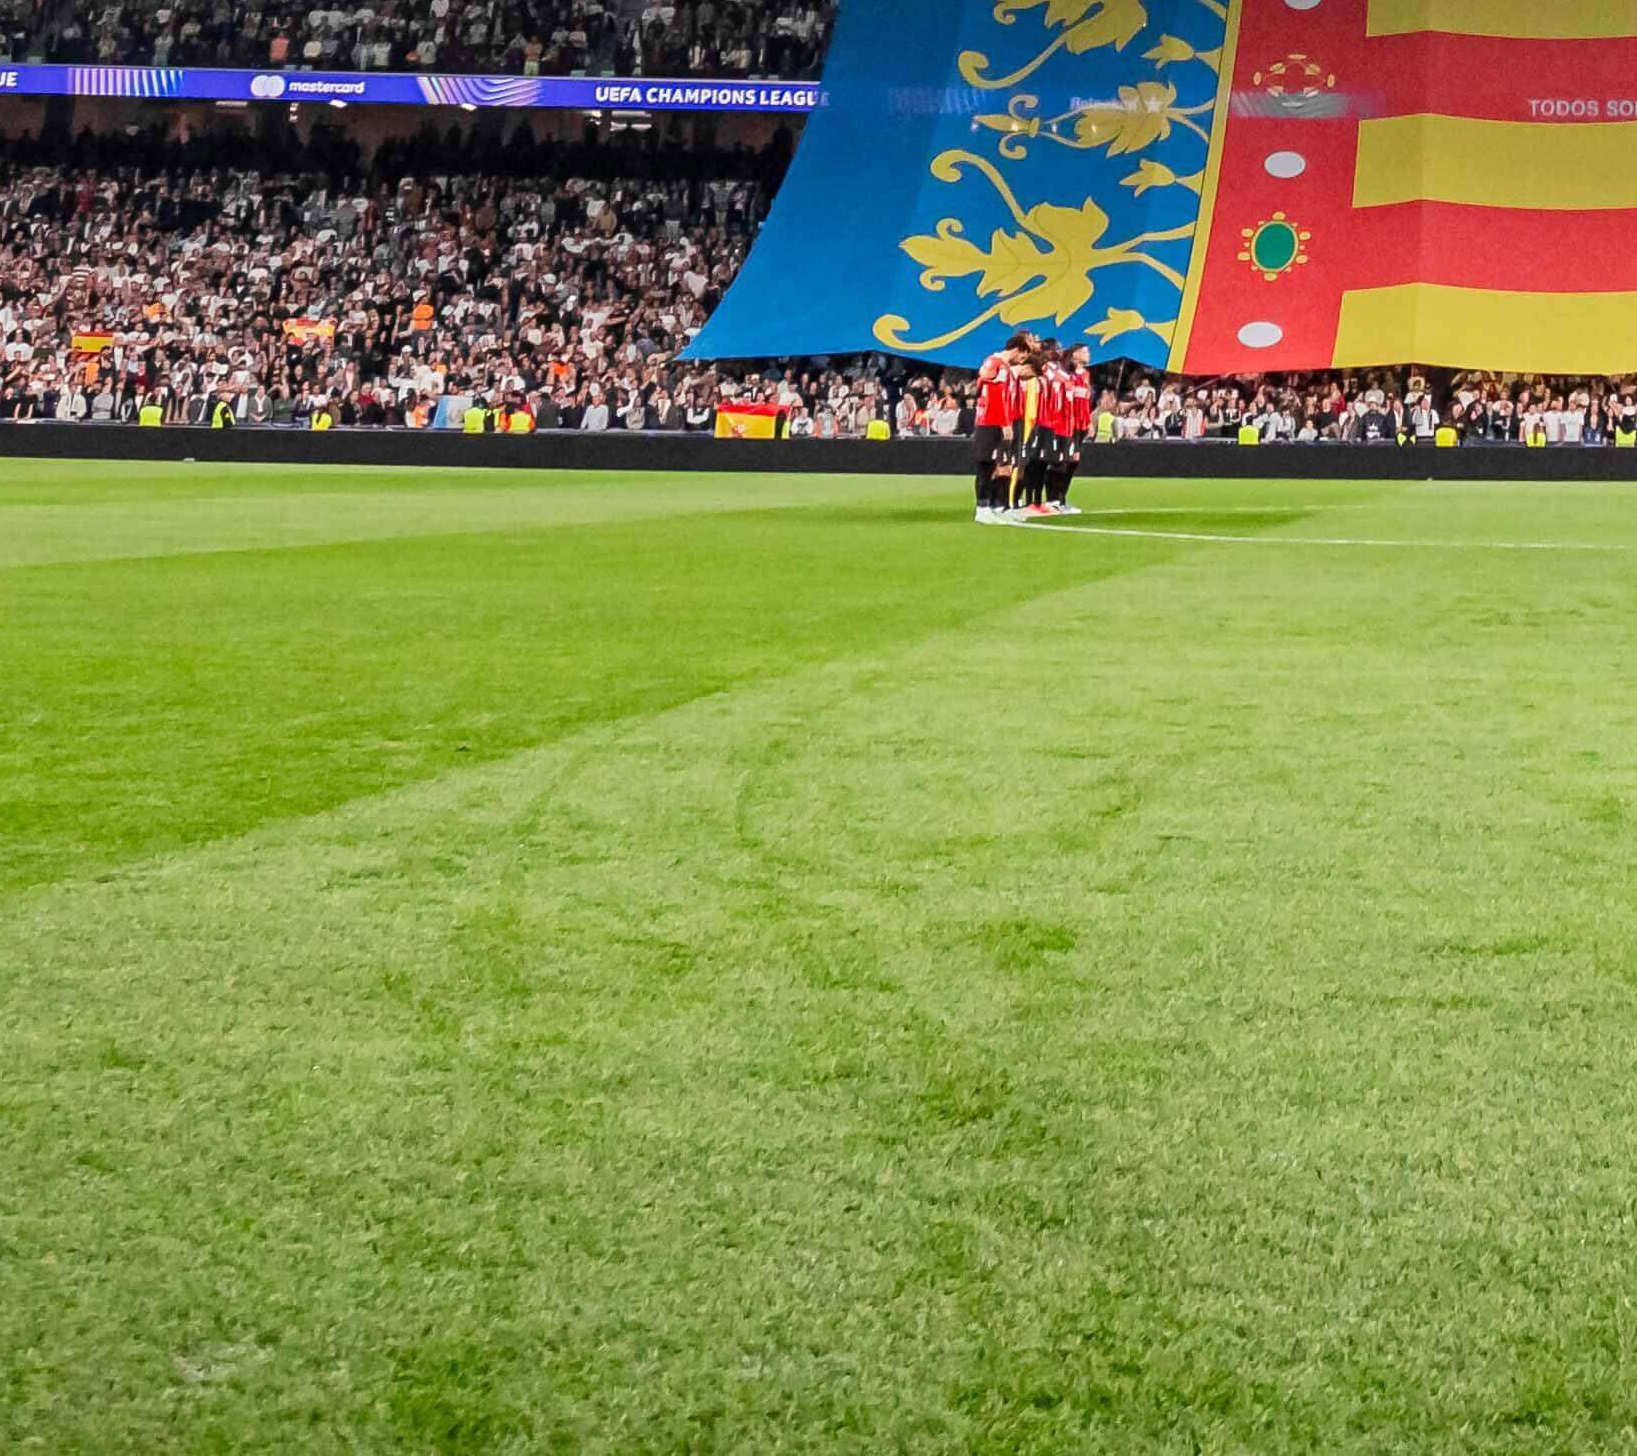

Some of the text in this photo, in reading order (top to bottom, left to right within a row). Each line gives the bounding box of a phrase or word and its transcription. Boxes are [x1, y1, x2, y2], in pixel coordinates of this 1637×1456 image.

[288, 81, 366, 94] mastercard
[595, 87, 643, 103] UEFA
[645, 87, 756, 105] CHAMPIONS
[1529, 99, 1599, 116] TODOS
